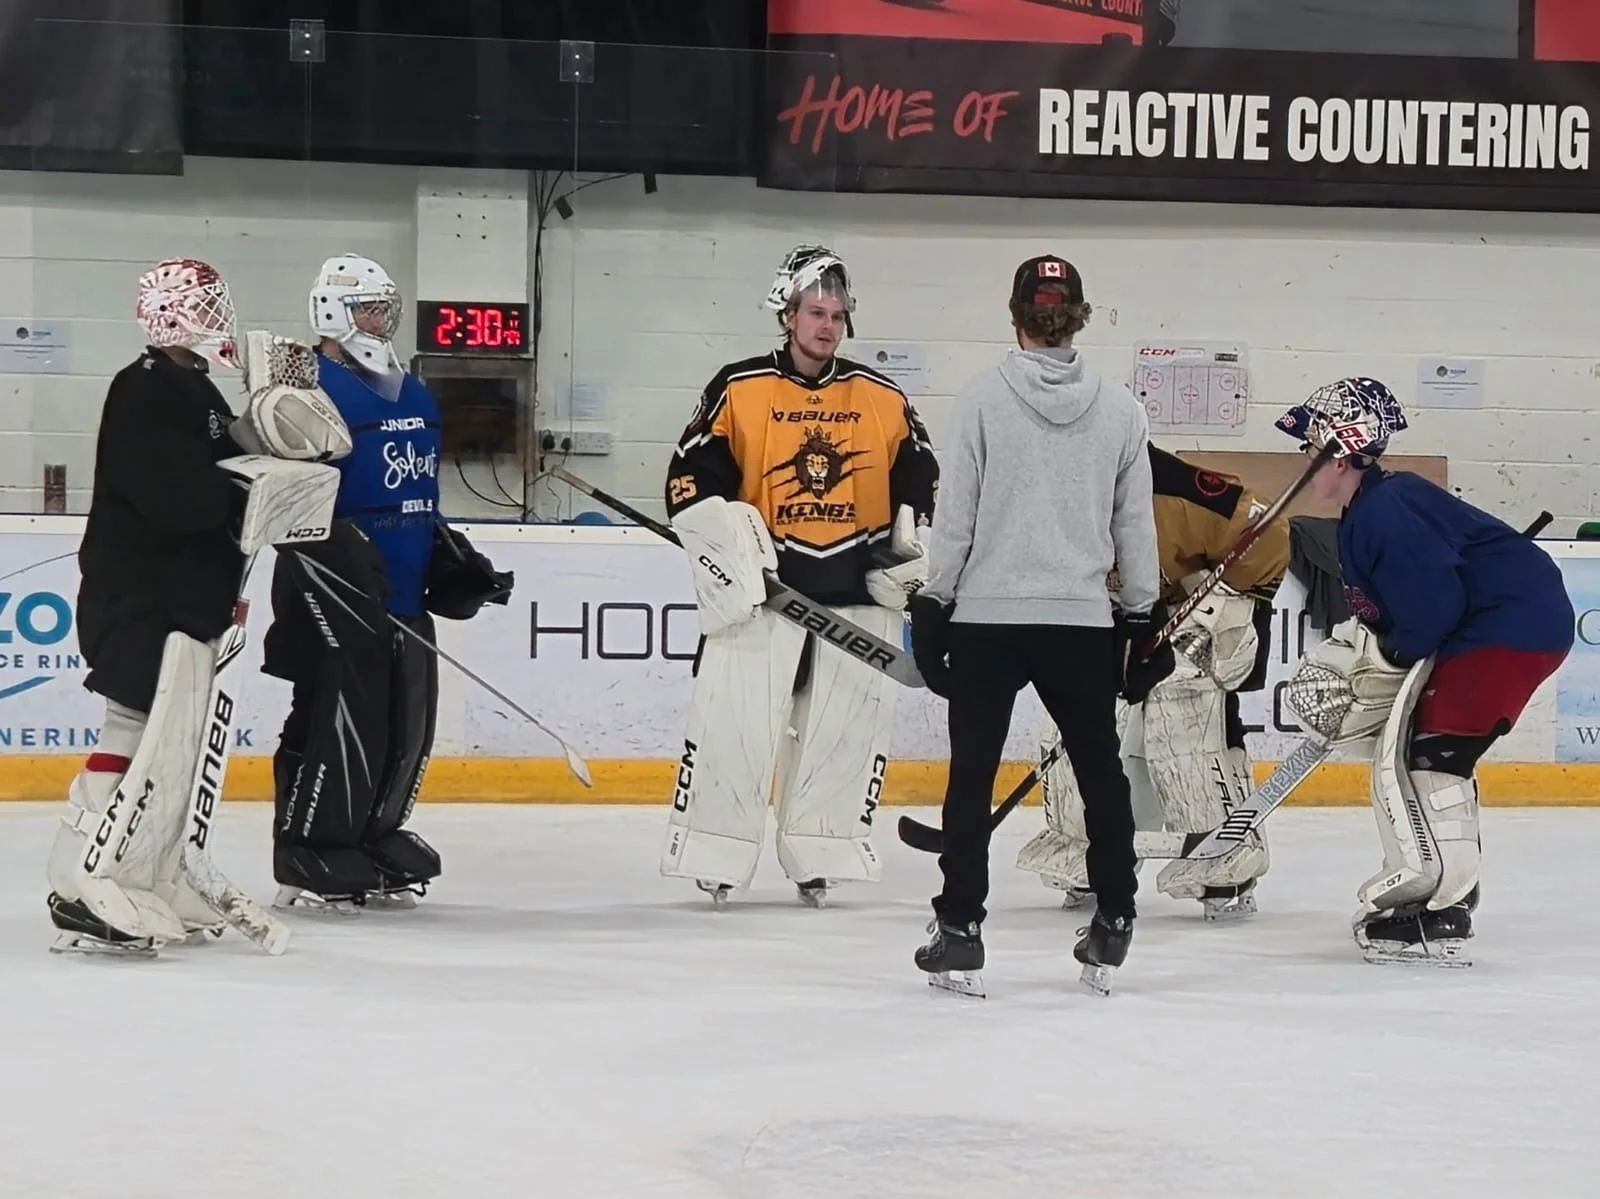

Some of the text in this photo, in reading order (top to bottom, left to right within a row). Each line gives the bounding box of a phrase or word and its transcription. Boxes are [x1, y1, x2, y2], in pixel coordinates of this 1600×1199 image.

[778, 75, 1590, 170] HOME OF REACTIVE COUNTERING
[434, 308, 503, 346] 2:30
[1139, 348, 1176, 356] CCM
[381, 417, 425, 431] JUNIOR
[787, 410, 862, 423] BAUER
[383, 441, 437, 489] Solent
[670, 475, 698, 505] 25
[286, 527, 327, 539] CCM
[402, 499, 433, 513] DEVILS
[698, 555, 733, 586] CCM
[1154, 563, 1225, 649] JETSPEED
[781, 599, 897, 671] BAUER
[188, 689, 234, 850] BAUER
[674, 738, 698, 813] CCM
[860, 753, 888, 826] CCM
[83, 787, 126, 874] CCM
[115, 778, 155, 863] CCM
[1407, 799, 1433, 862] WARRIOR
